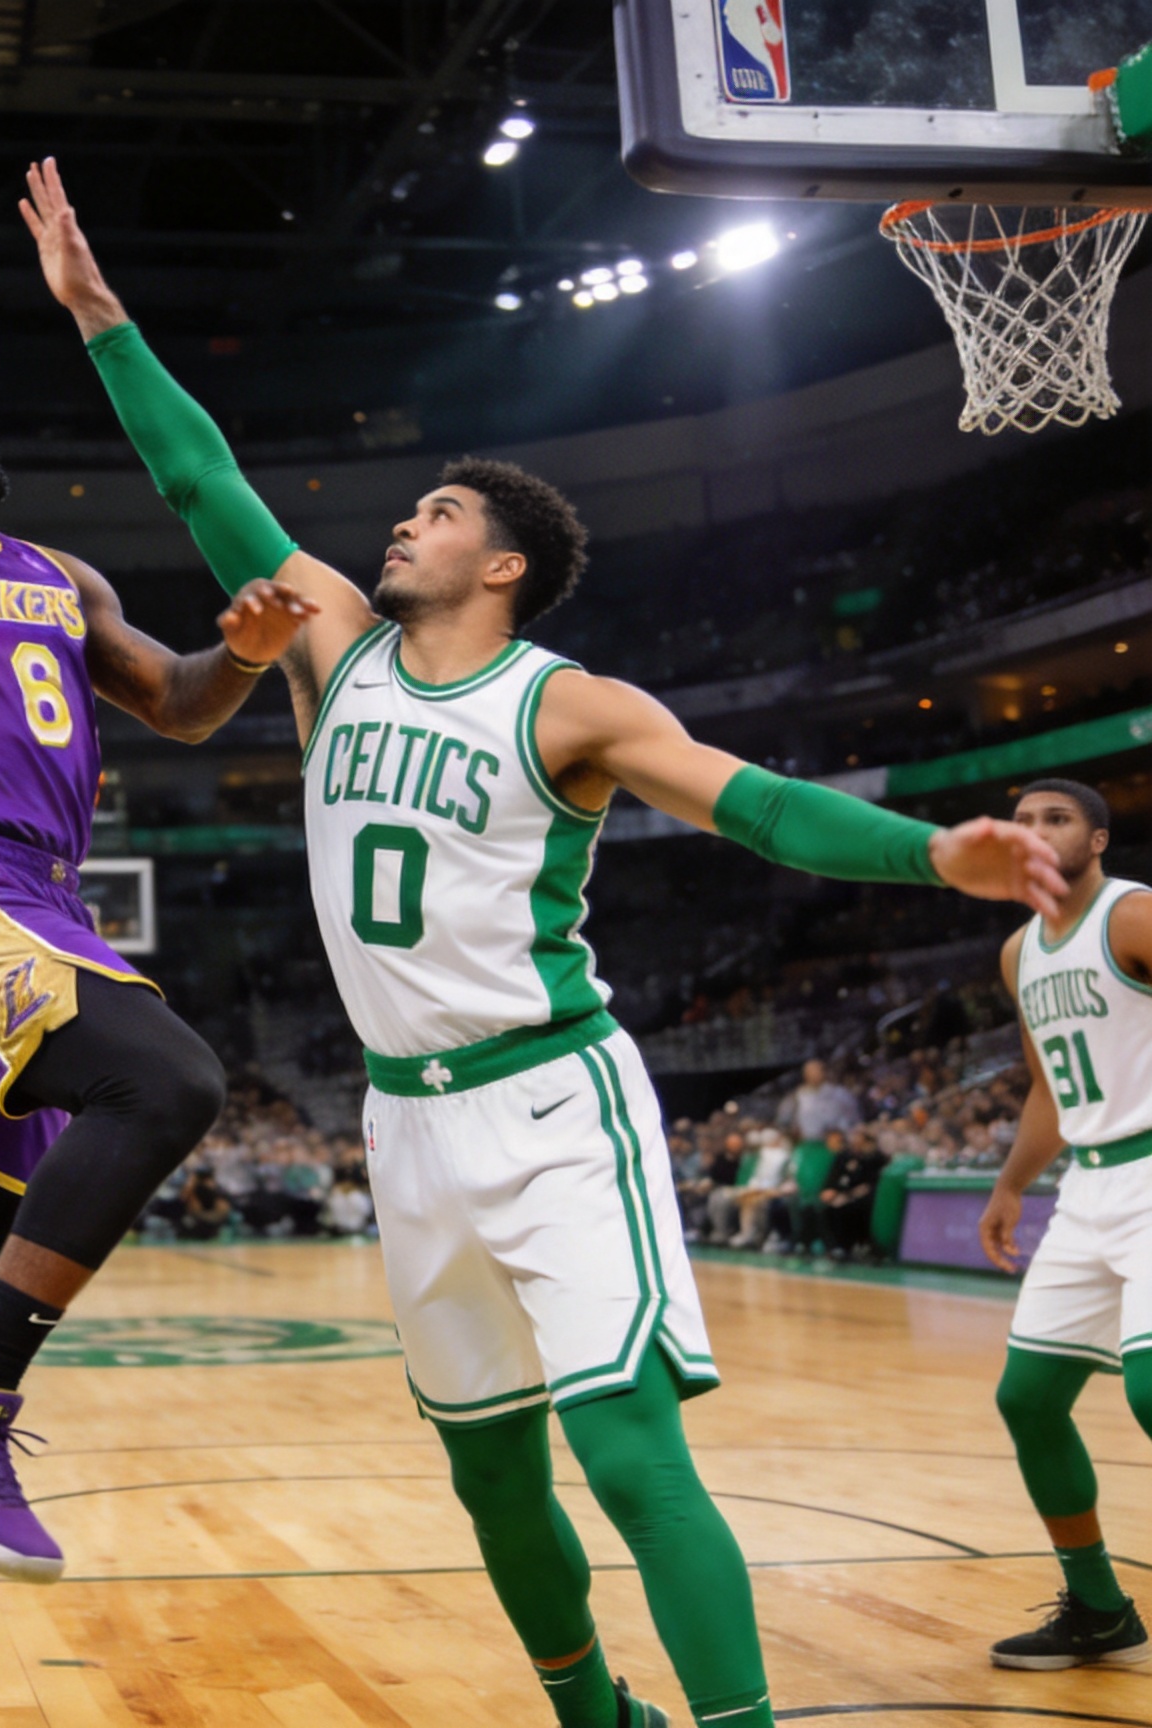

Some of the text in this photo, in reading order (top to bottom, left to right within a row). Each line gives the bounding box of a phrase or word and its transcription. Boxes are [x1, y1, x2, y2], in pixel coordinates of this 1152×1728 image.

[323, 721, 499, 835] CELTICS
[351, 822, 430, 949] 0
[1043, 1029, 1105, 1109] 31
